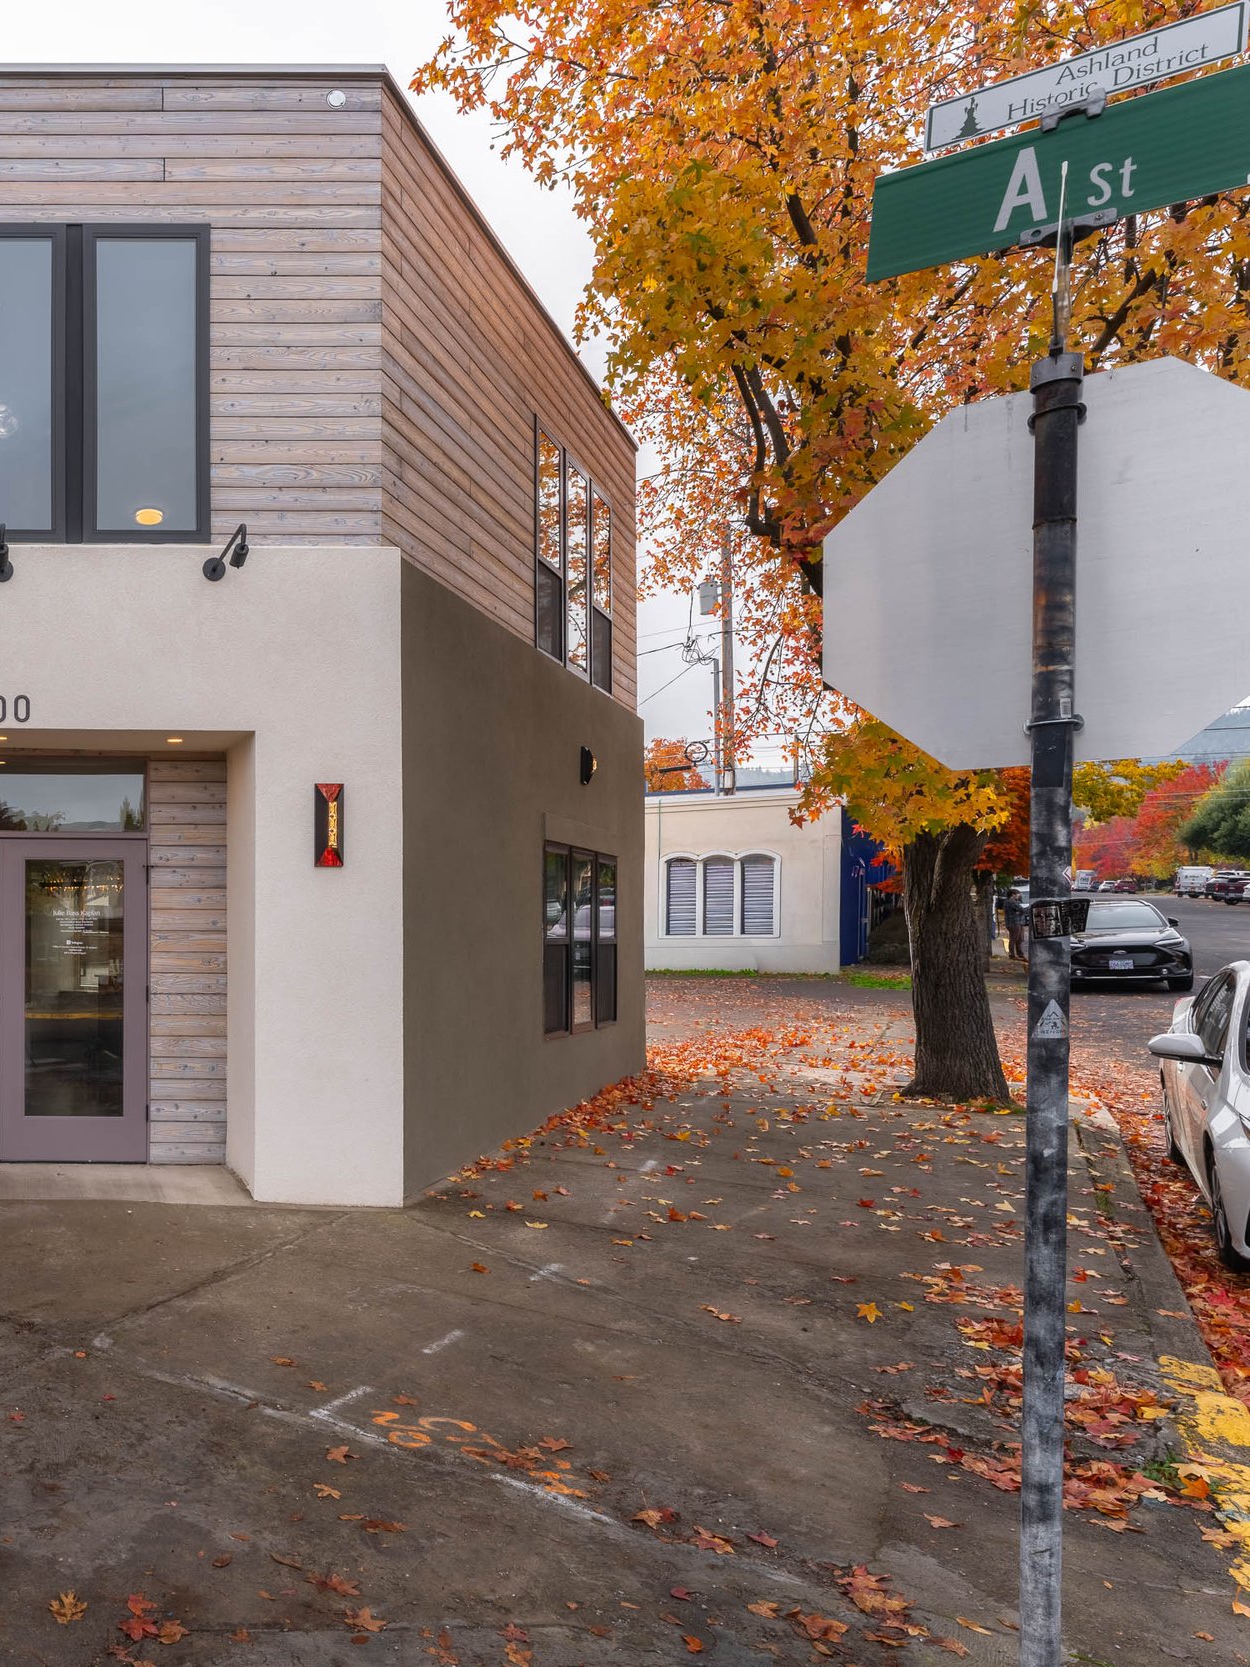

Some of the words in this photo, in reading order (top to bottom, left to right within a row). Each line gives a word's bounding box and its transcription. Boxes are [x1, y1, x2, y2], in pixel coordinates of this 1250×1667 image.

[1007, 81, 1098, 121] Historic
[1112, 44, 1210, 87] District
[1056, 36, 1159, 86] Ashland
[993, 146, 1048, 233] A
[1087, 156, 1138, 207] St
